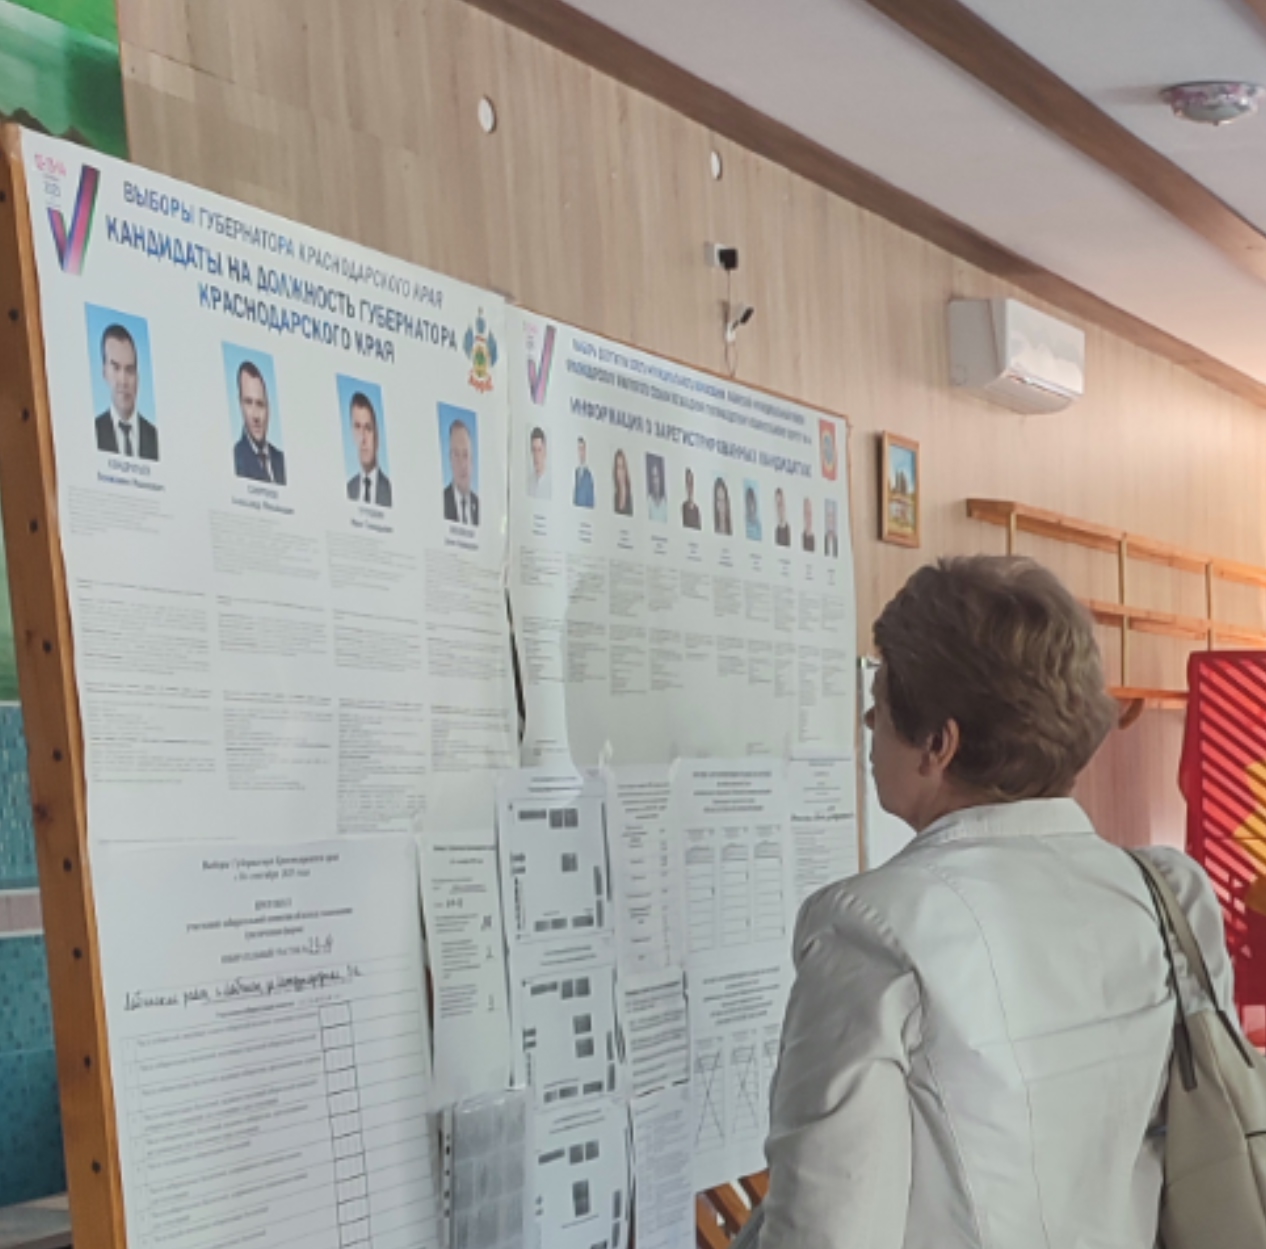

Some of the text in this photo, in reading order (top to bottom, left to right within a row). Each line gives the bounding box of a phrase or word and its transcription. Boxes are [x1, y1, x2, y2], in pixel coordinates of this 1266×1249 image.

[105, 214, 458, 351] КАНДИДАТЫ НА ДОЛЖНОСТЬ ГУБЕРНАТОРА
[123, 181, 444, 310] ВЫБОРЫ ГУБЕРНАТОРА КРАСНОДАРСКОГО КРАЯ
[198, 281, 396, 364] КРАСНОДАРСКОГО КРАЯ
[569, 396, 645, 433] ИНФОРМАЦИЯ
